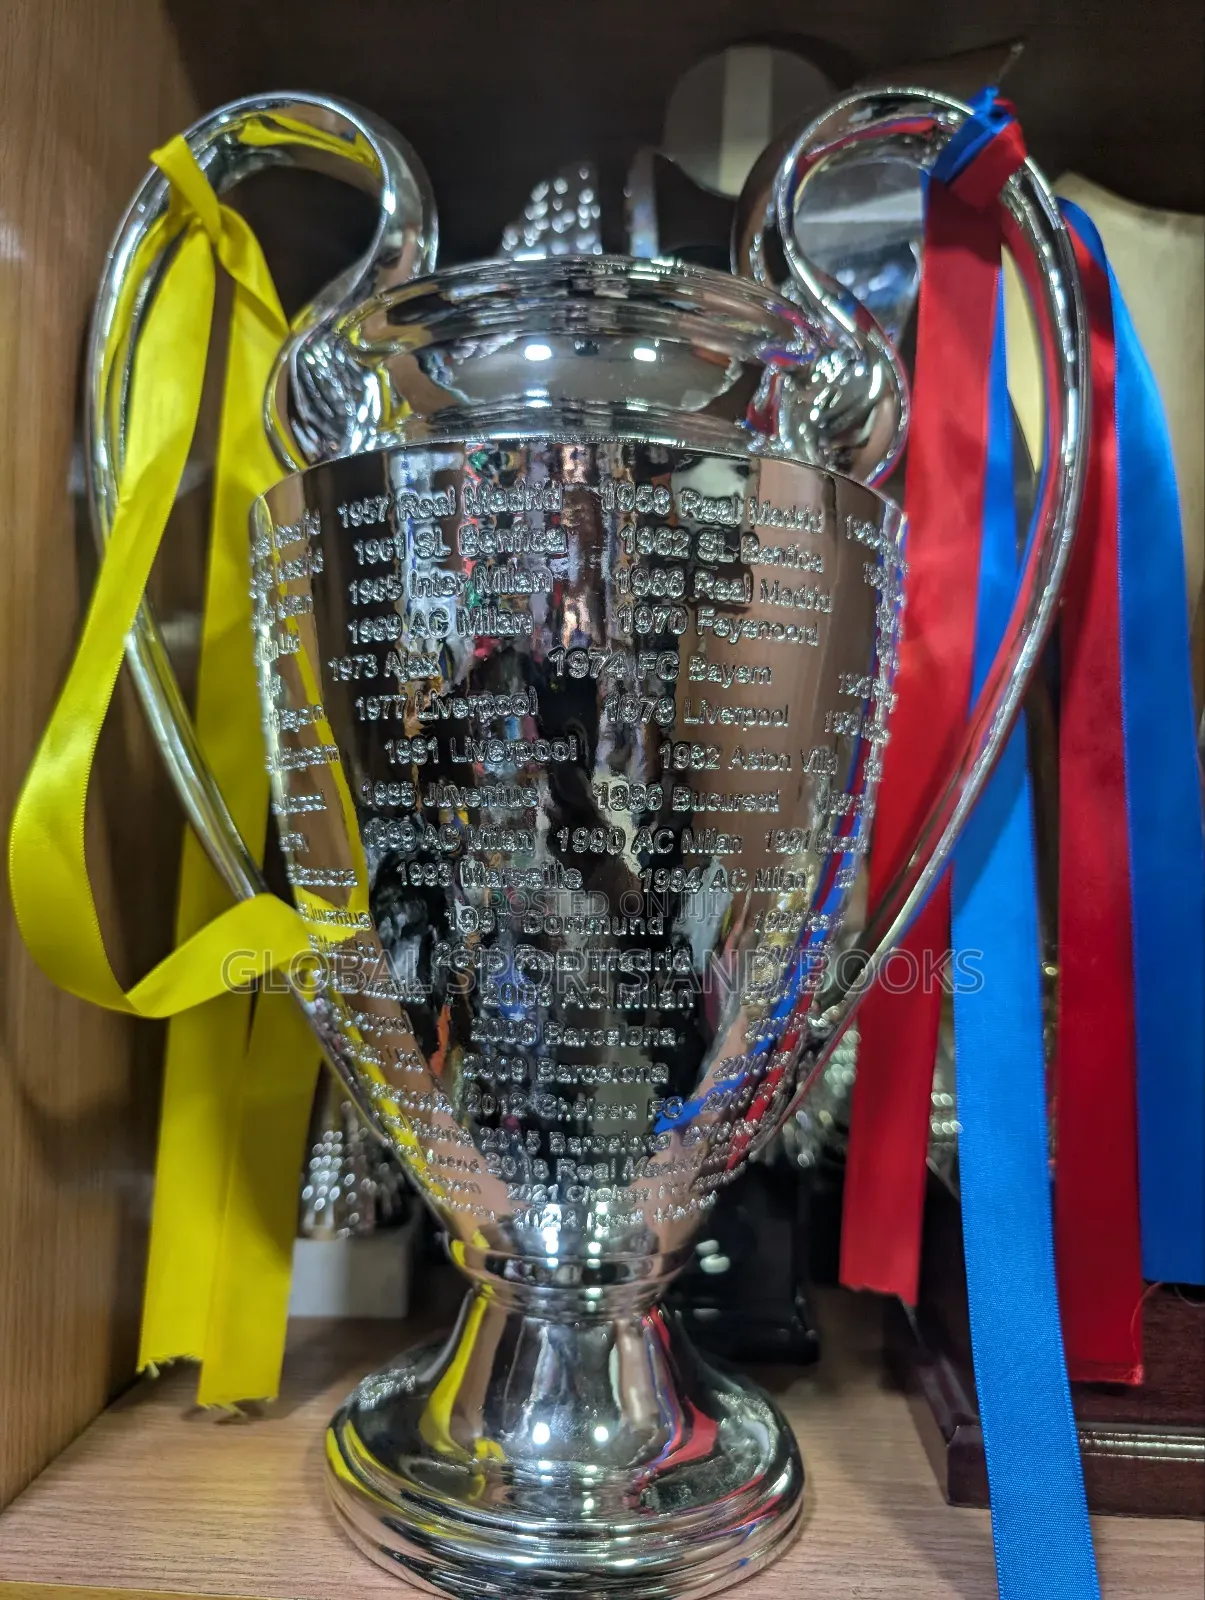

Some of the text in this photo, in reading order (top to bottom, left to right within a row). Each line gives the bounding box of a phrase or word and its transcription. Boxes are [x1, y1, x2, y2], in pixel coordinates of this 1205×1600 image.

[337, 477, 563, 528] 1957 Real Madrid
[600, 483, 824, 533] 1958 Real Madrid
[415, 528, 451, 558] SL
[459, 523, 567, 555] Benfica
[620, 525, 824, 574] 1962 SL Benfica
[408, 567, 467, 599] Inter
[470, 563, 554, 595] Milan
[694, 570, 751, 603] Real
[759, 577, 833, 613] Madrid
[408, 605, 450, 640] AC
[456, 605, 534, 637] Milan
[616, 603, 819, 648] 1970 Feyenoord
[328, 651, 440, 683] 1973 Ajax
[548, 648, 627, 680] 1974
[635, 650, 681, 681] FC
[354, 685, 539, 722] 1977 Liverpool
[683, 700, 789, 732] Liverpool
[383, 734, 578, 769] 1981 Liverpool
[658, 741, 722, 771] 1982
[727, 743, 793, 772] Aston
[801, 744, 839, 775] Villa
[421, 822, 462, 851] AC
[556, 825, 744, 855] 1990 AC Milan
[396, 857, 584, 889] 1993 Marseille
[638, 867, 703, 893] 1994
[708, 868, 749, 894] AC
[753, 866, 806, 893] Milan
[544, 1020, 677, 1048] Barcelona
[536, 1055, 670, 1084] Barcelona
[649, 1096, 684, 1120] FC
[556, 1157, 617, 1183] Real
